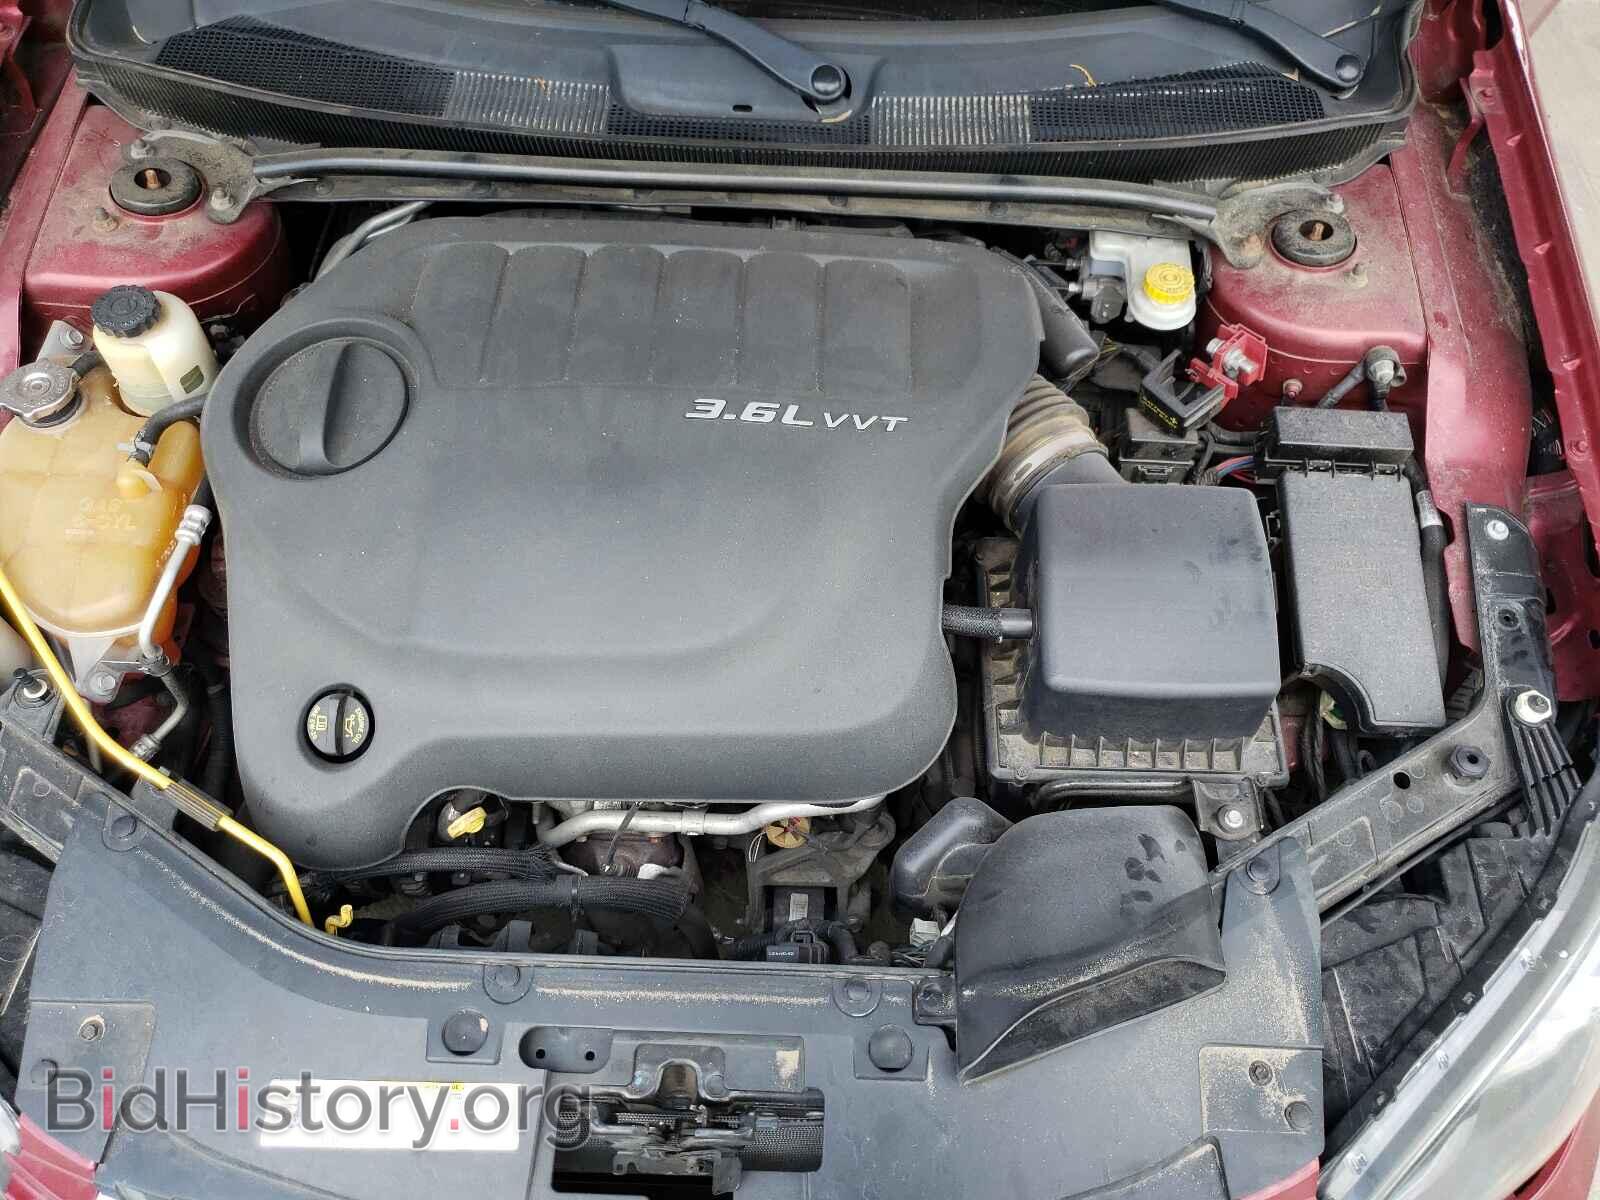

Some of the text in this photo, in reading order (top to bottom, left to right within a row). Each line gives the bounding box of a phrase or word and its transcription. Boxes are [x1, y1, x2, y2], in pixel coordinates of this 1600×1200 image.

[685, 398, 909, 432] 3.6L VVT
[351, 733, 362, 744] OIL
